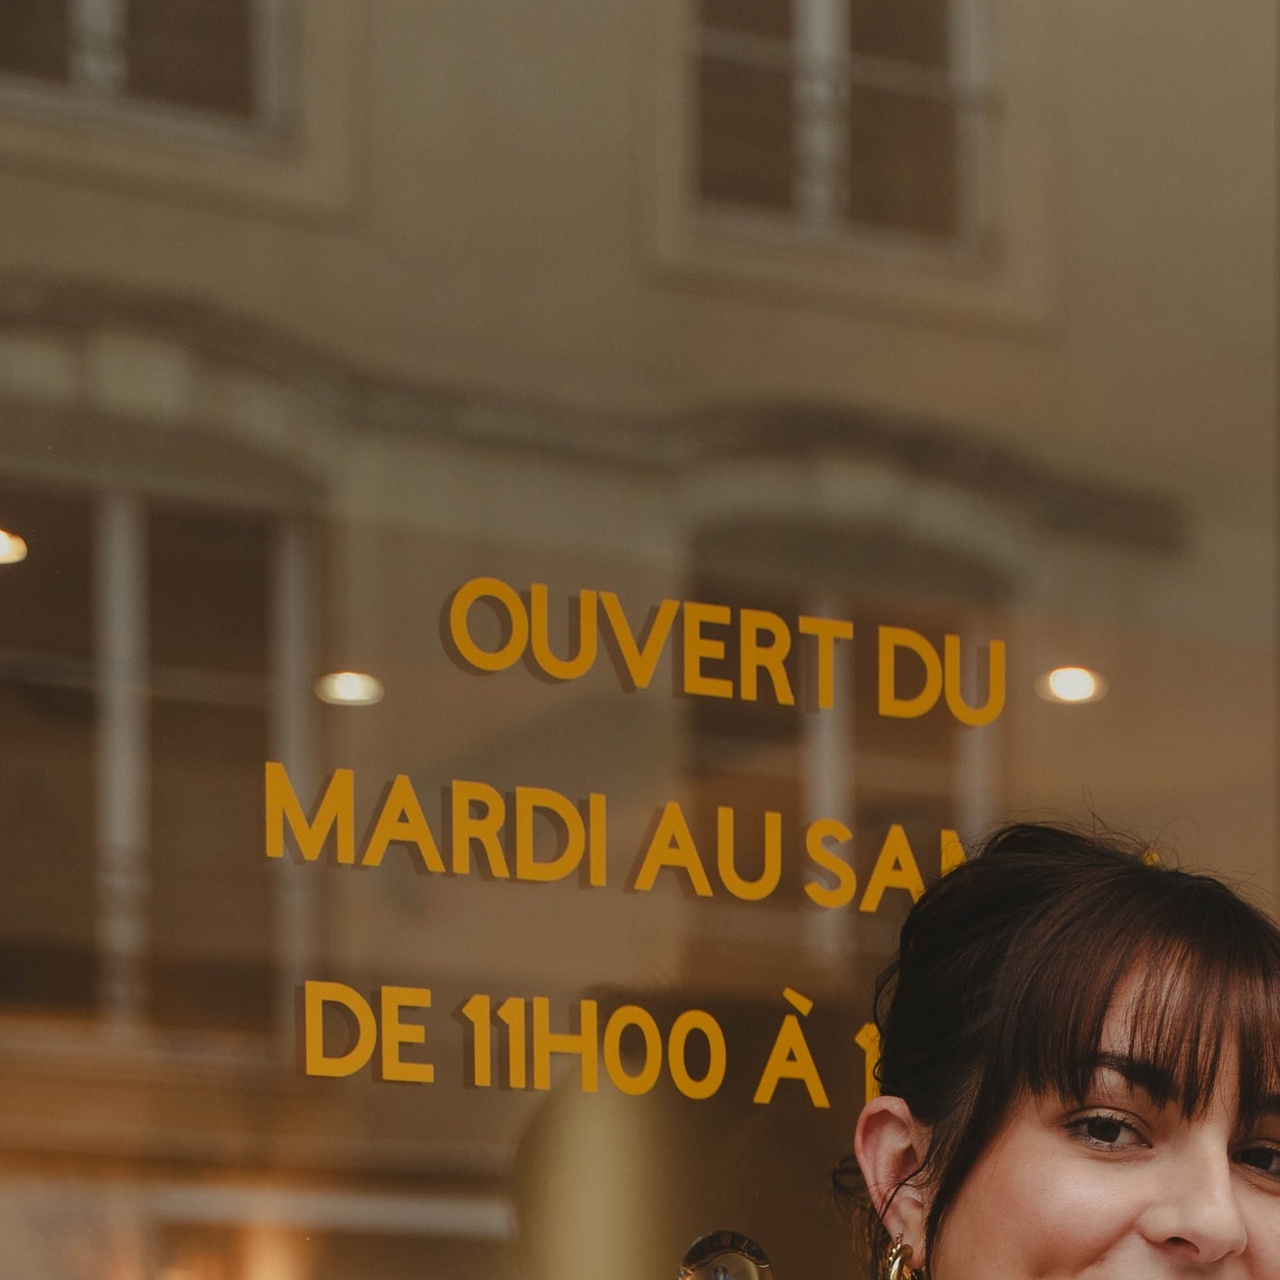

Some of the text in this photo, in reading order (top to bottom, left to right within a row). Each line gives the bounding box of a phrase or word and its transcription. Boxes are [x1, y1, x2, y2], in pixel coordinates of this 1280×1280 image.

[449, 576, 1006, 727] OUVERT DU
[264, 761, 607, 887] MARDI
[633, 799, 782, 901] AU
[304, 979, 435, 1084] DE
[461, 993, 727, 1100] 11H00
[753, 987, 830, 1108] À
